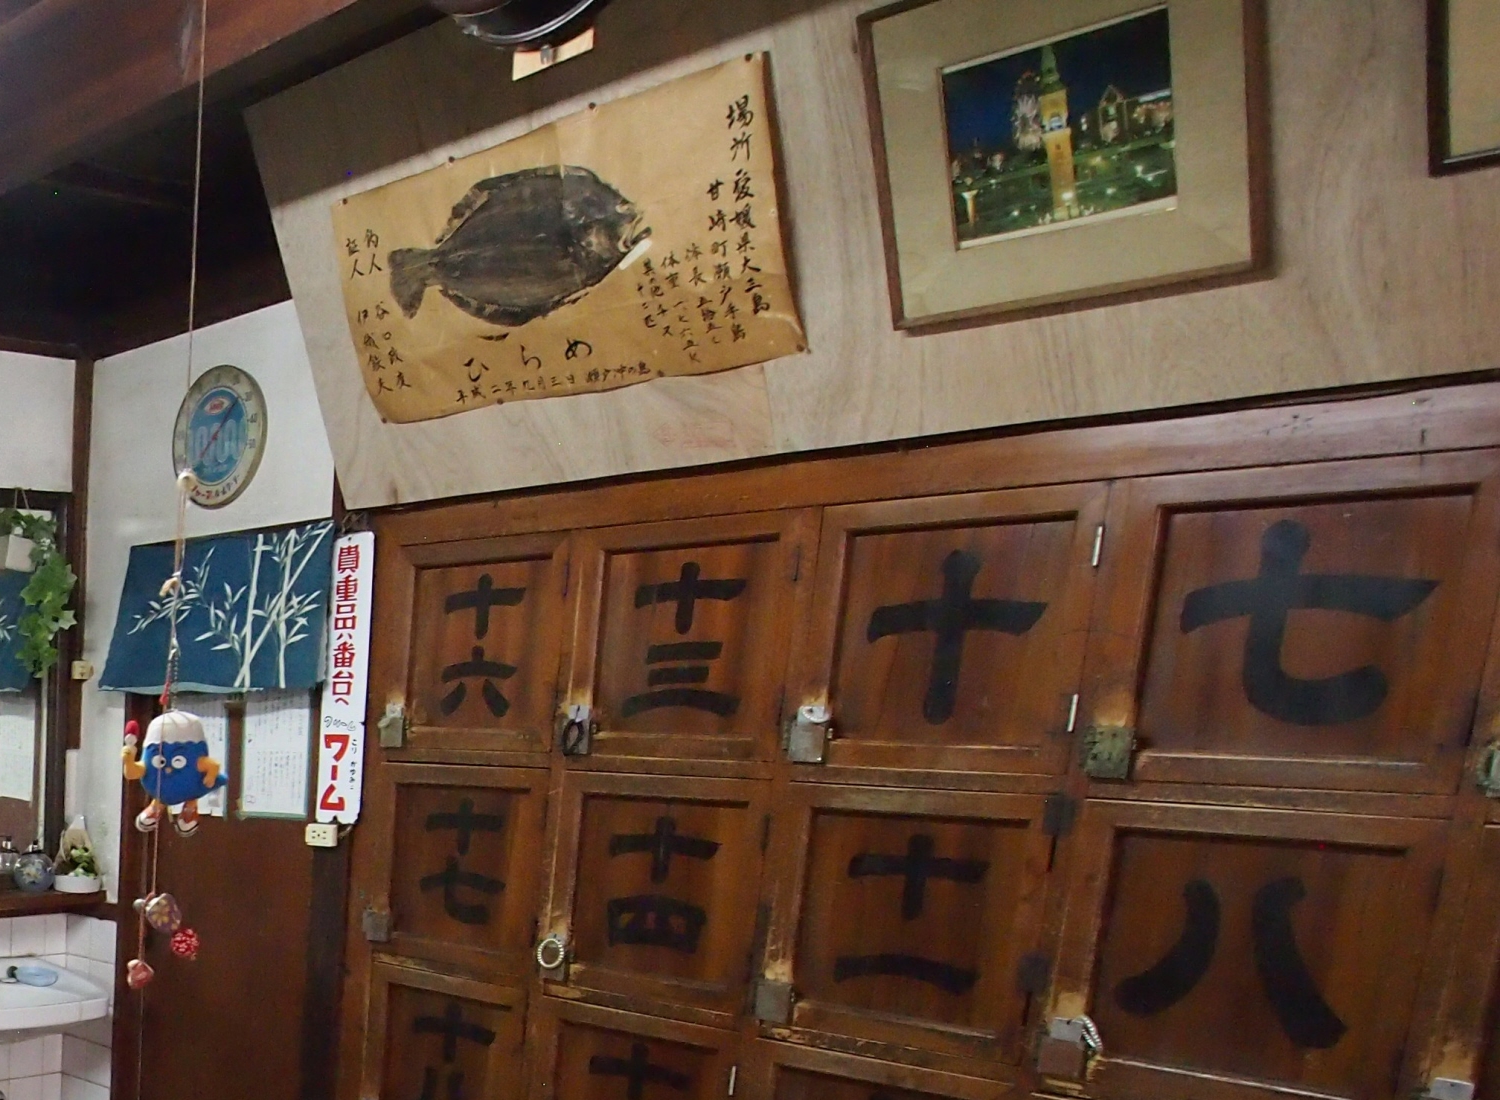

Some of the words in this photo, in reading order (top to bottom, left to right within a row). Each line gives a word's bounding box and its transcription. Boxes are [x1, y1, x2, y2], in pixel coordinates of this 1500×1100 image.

[440, 572, 527, 718] 十六
[622, 561, 747, 719] 十三
[867, 549, 1047, 725] 十
[1180, 518, 1440, 726] 七
[319, 734, 351, 811] ワーム
[419, 797, 506, 925] 十七
[607, 816, 723, 954] 十四
[833, 833, 990, 995] 十一
[1114, 877, 1349, 1050] 八
